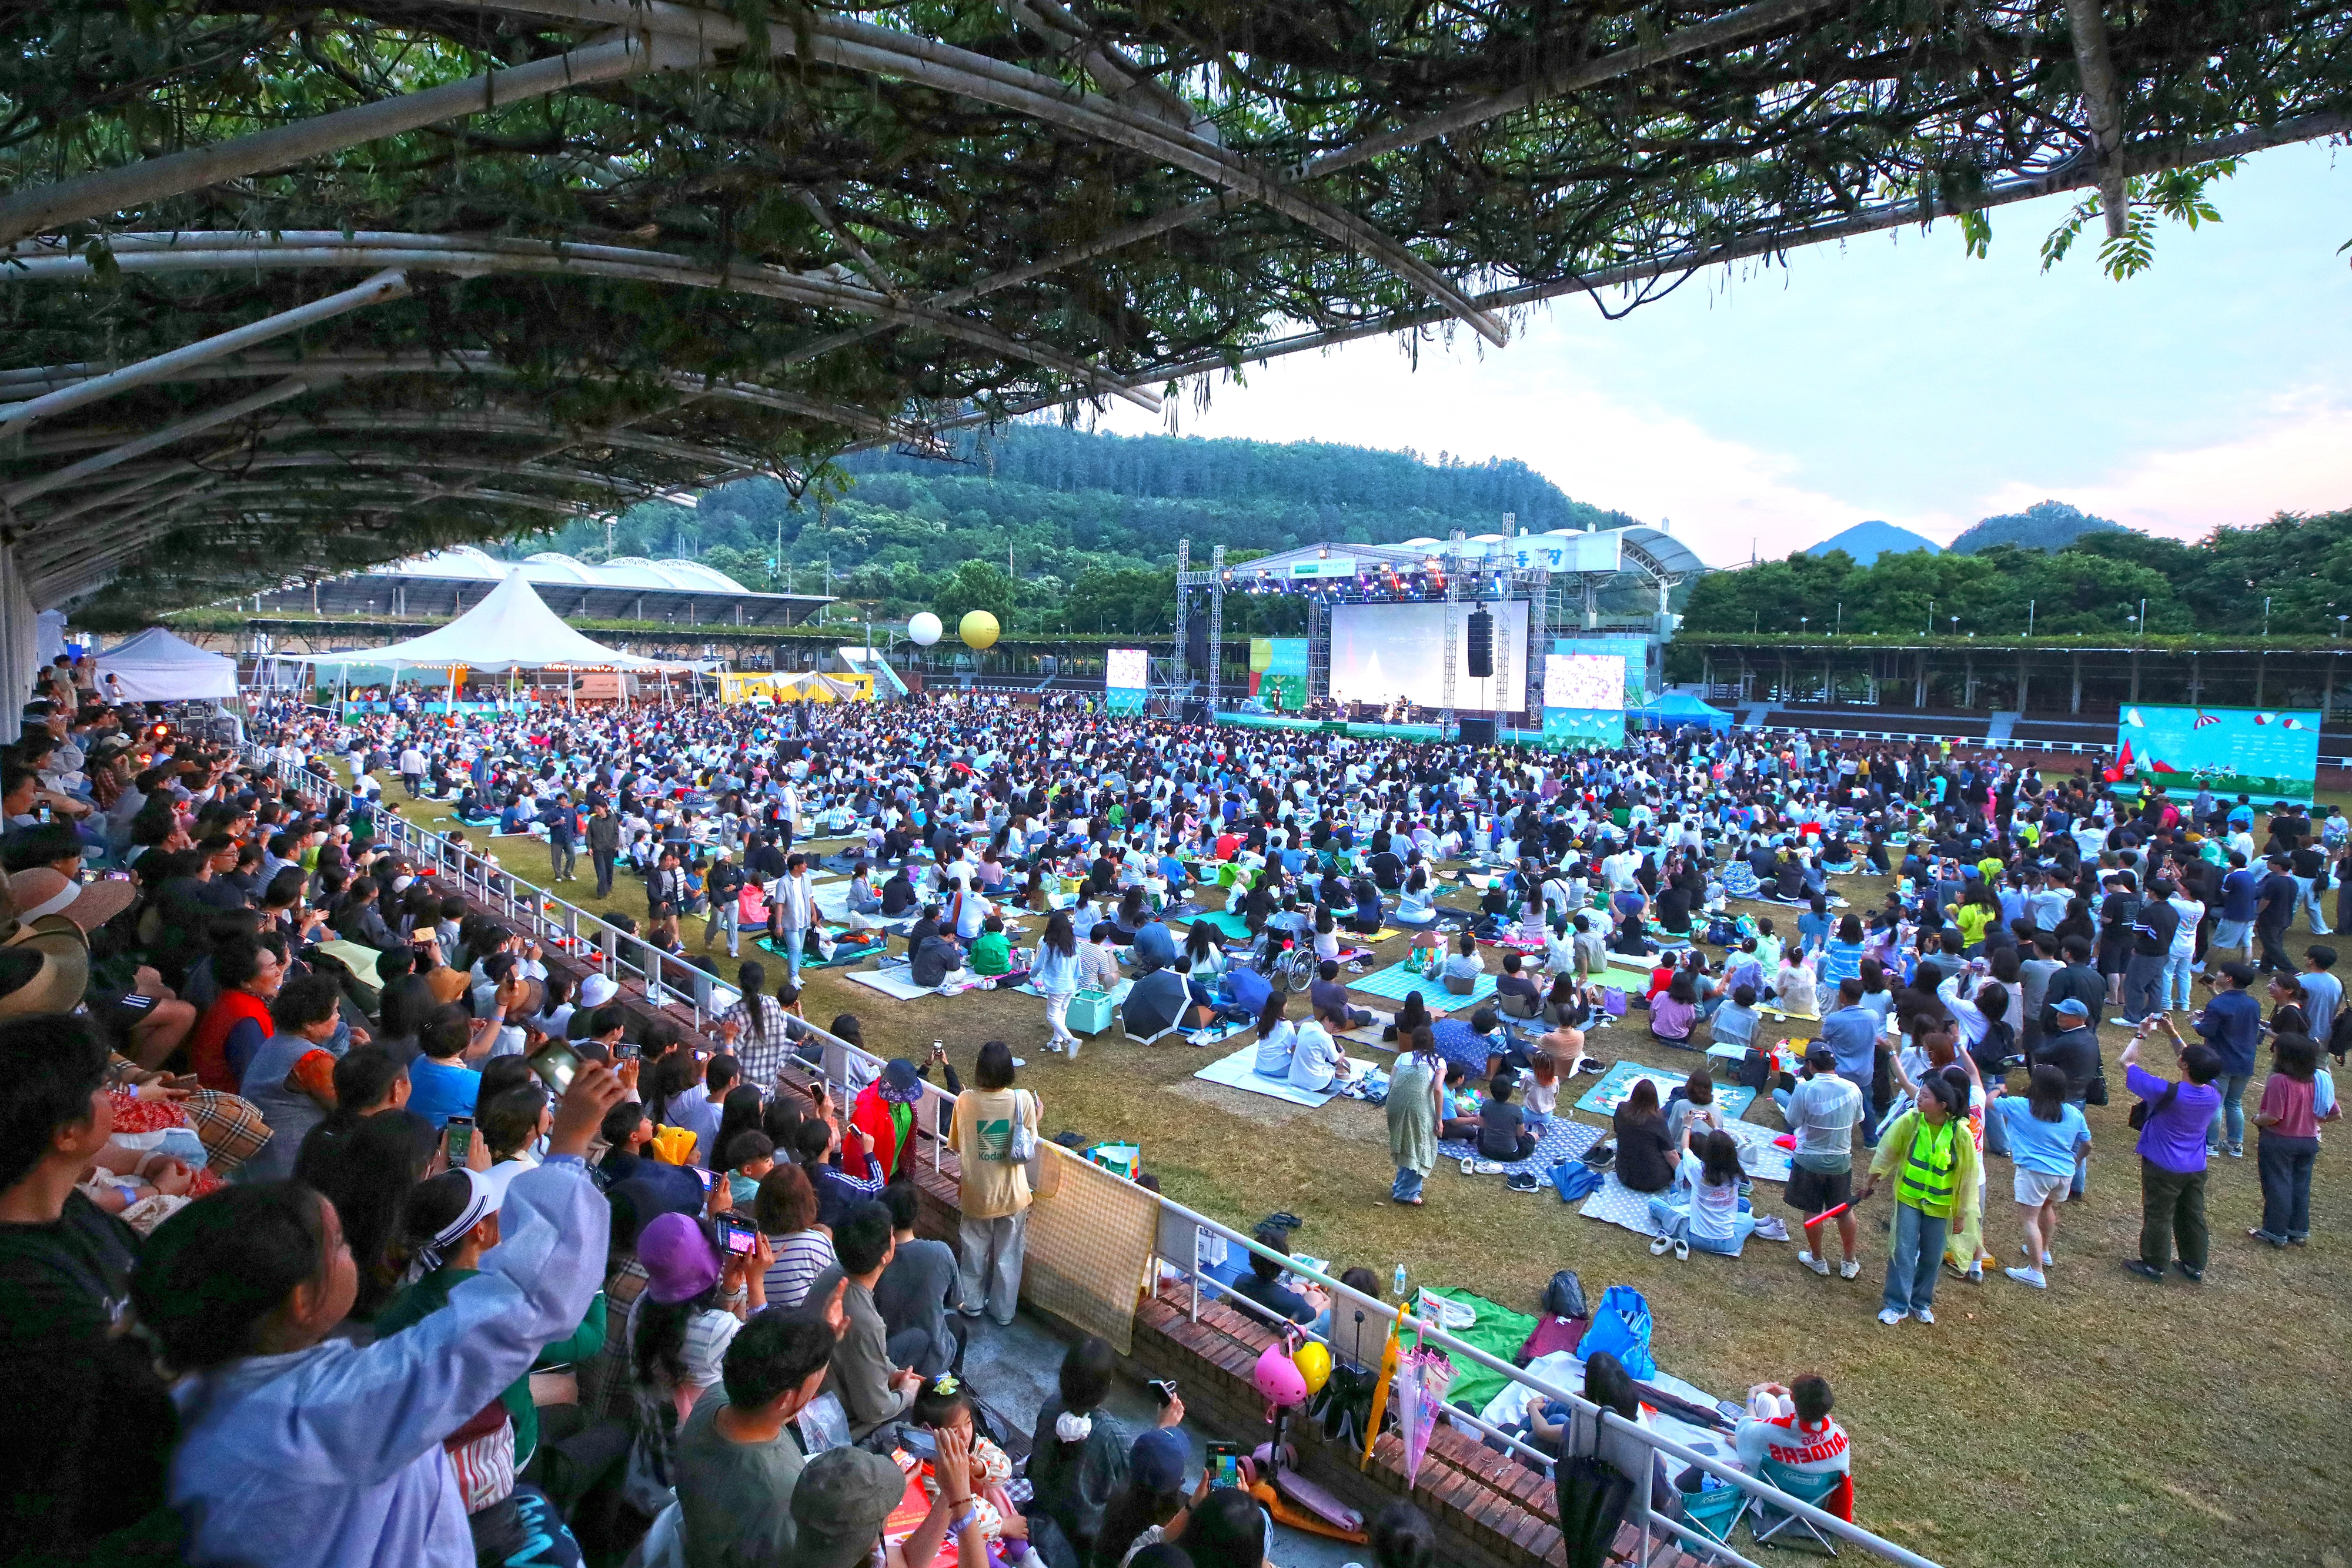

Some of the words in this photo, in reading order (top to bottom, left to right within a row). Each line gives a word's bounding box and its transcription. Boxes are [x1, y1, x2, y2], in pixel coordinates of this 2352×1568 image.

[1291, 641, 1307, 649] Muju
[978, 1151, 1007, 1161] Kodak
[1423, 1302, 1438, 1315] Milk
